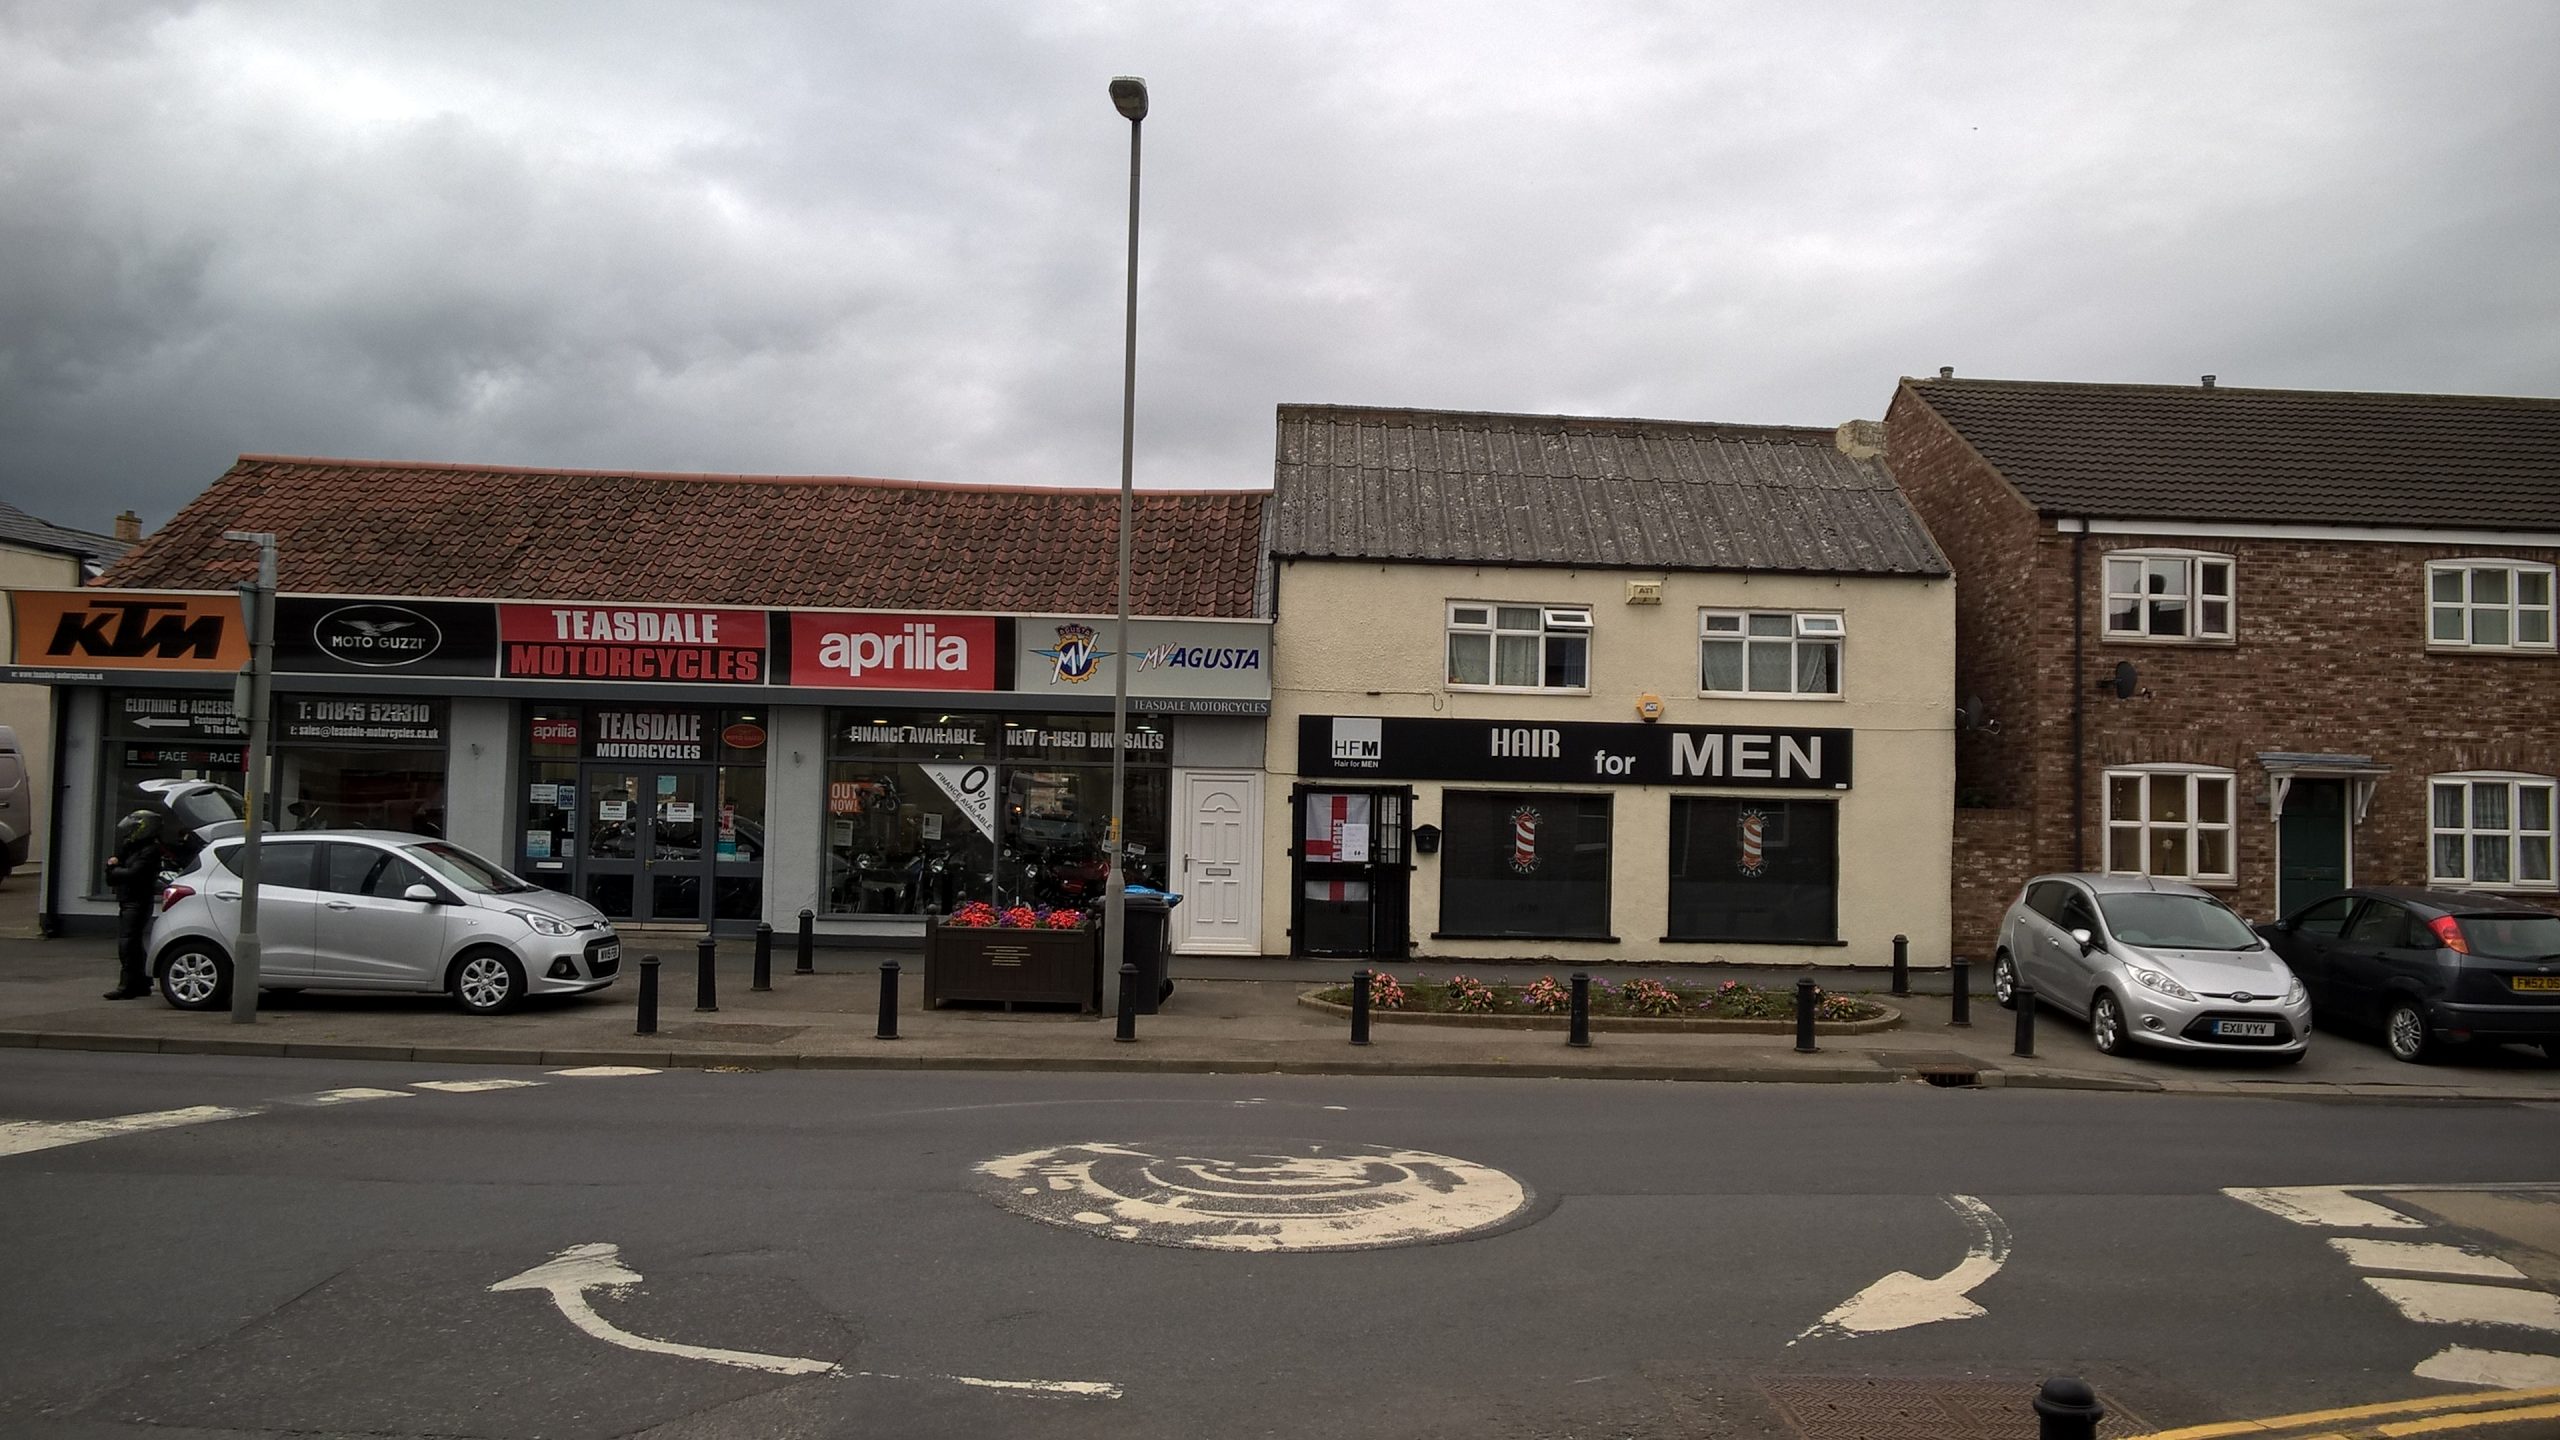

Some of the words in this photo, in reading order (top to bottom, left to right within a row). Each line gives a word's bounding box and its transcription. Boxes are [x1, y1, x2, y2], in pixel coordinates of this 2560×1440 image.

[46, 600, 225, 659] KTM
[552, 609, 719, 643] TEASDALE
[1059, 626, 1091, 636] AGUSTA
[332, 635, 373, 648] MOTO
[378, 637, 422, 650] GUZZI
[819, 623, 968, 677] aprilia
[510, 645, 758, 681] MOTORCYCLES
[1050, 632, 1101, 685] MV
[1137, 642, 1176, 672] MV
[1169, 647, 1260, 670] AGUSTA
[125, 698, 177, 713] CLOTHING
[180, 699, 188, 713] &
[191, 700, 235, 715] ACCESS
[298, 702, 311, 720] T:
[316, 702, 366, 721] 01845
[370, 703, 430, 722] 523310
[1134, 700, 1186, 711] TEASDALE
[1190, 702, 1268, 713] MOTORCYCLES
[194, 716, 225, 725] Customer
[598, 712, 701, 742] TEASDALE
[299, 724, 439, 740] sales@teasdale-motorcycles.co.uk
[533, 724, 577, 740] aprilia
[850, 726, 905, 743] FINANCE
[909, 728, 977, 745] AVAILABLE
[1006, 729, 1035, 746] NEW
[1039, 731, 1048, 746] &
[1053, 731, 1086, 748] USED
[1090, 732, 1115, 748] BIK
[1124, 733, 1164, 750] SALES
[158, 750, 188, 762] FACE
[209, 752, 241, 763] RACE
[596, 743, 701, 760] MOTORCYCLES
[1335, 740, 1378, 756] HFM
[1491, 727, 1560, 758] HAIR
[1594, 749, 1636, 775] for
[1671, 732, 1821, 779] MEN
[831, 783, 859, 799] OUT
[960, 765, 991, 810] 0%
[830, 799, 859, 812] NOW!
[935, 772, 963, 799] FINANCE
[960, 798, 993, 831] AVAILABLE
[2245, 1024, 2267, 1035] VYV
